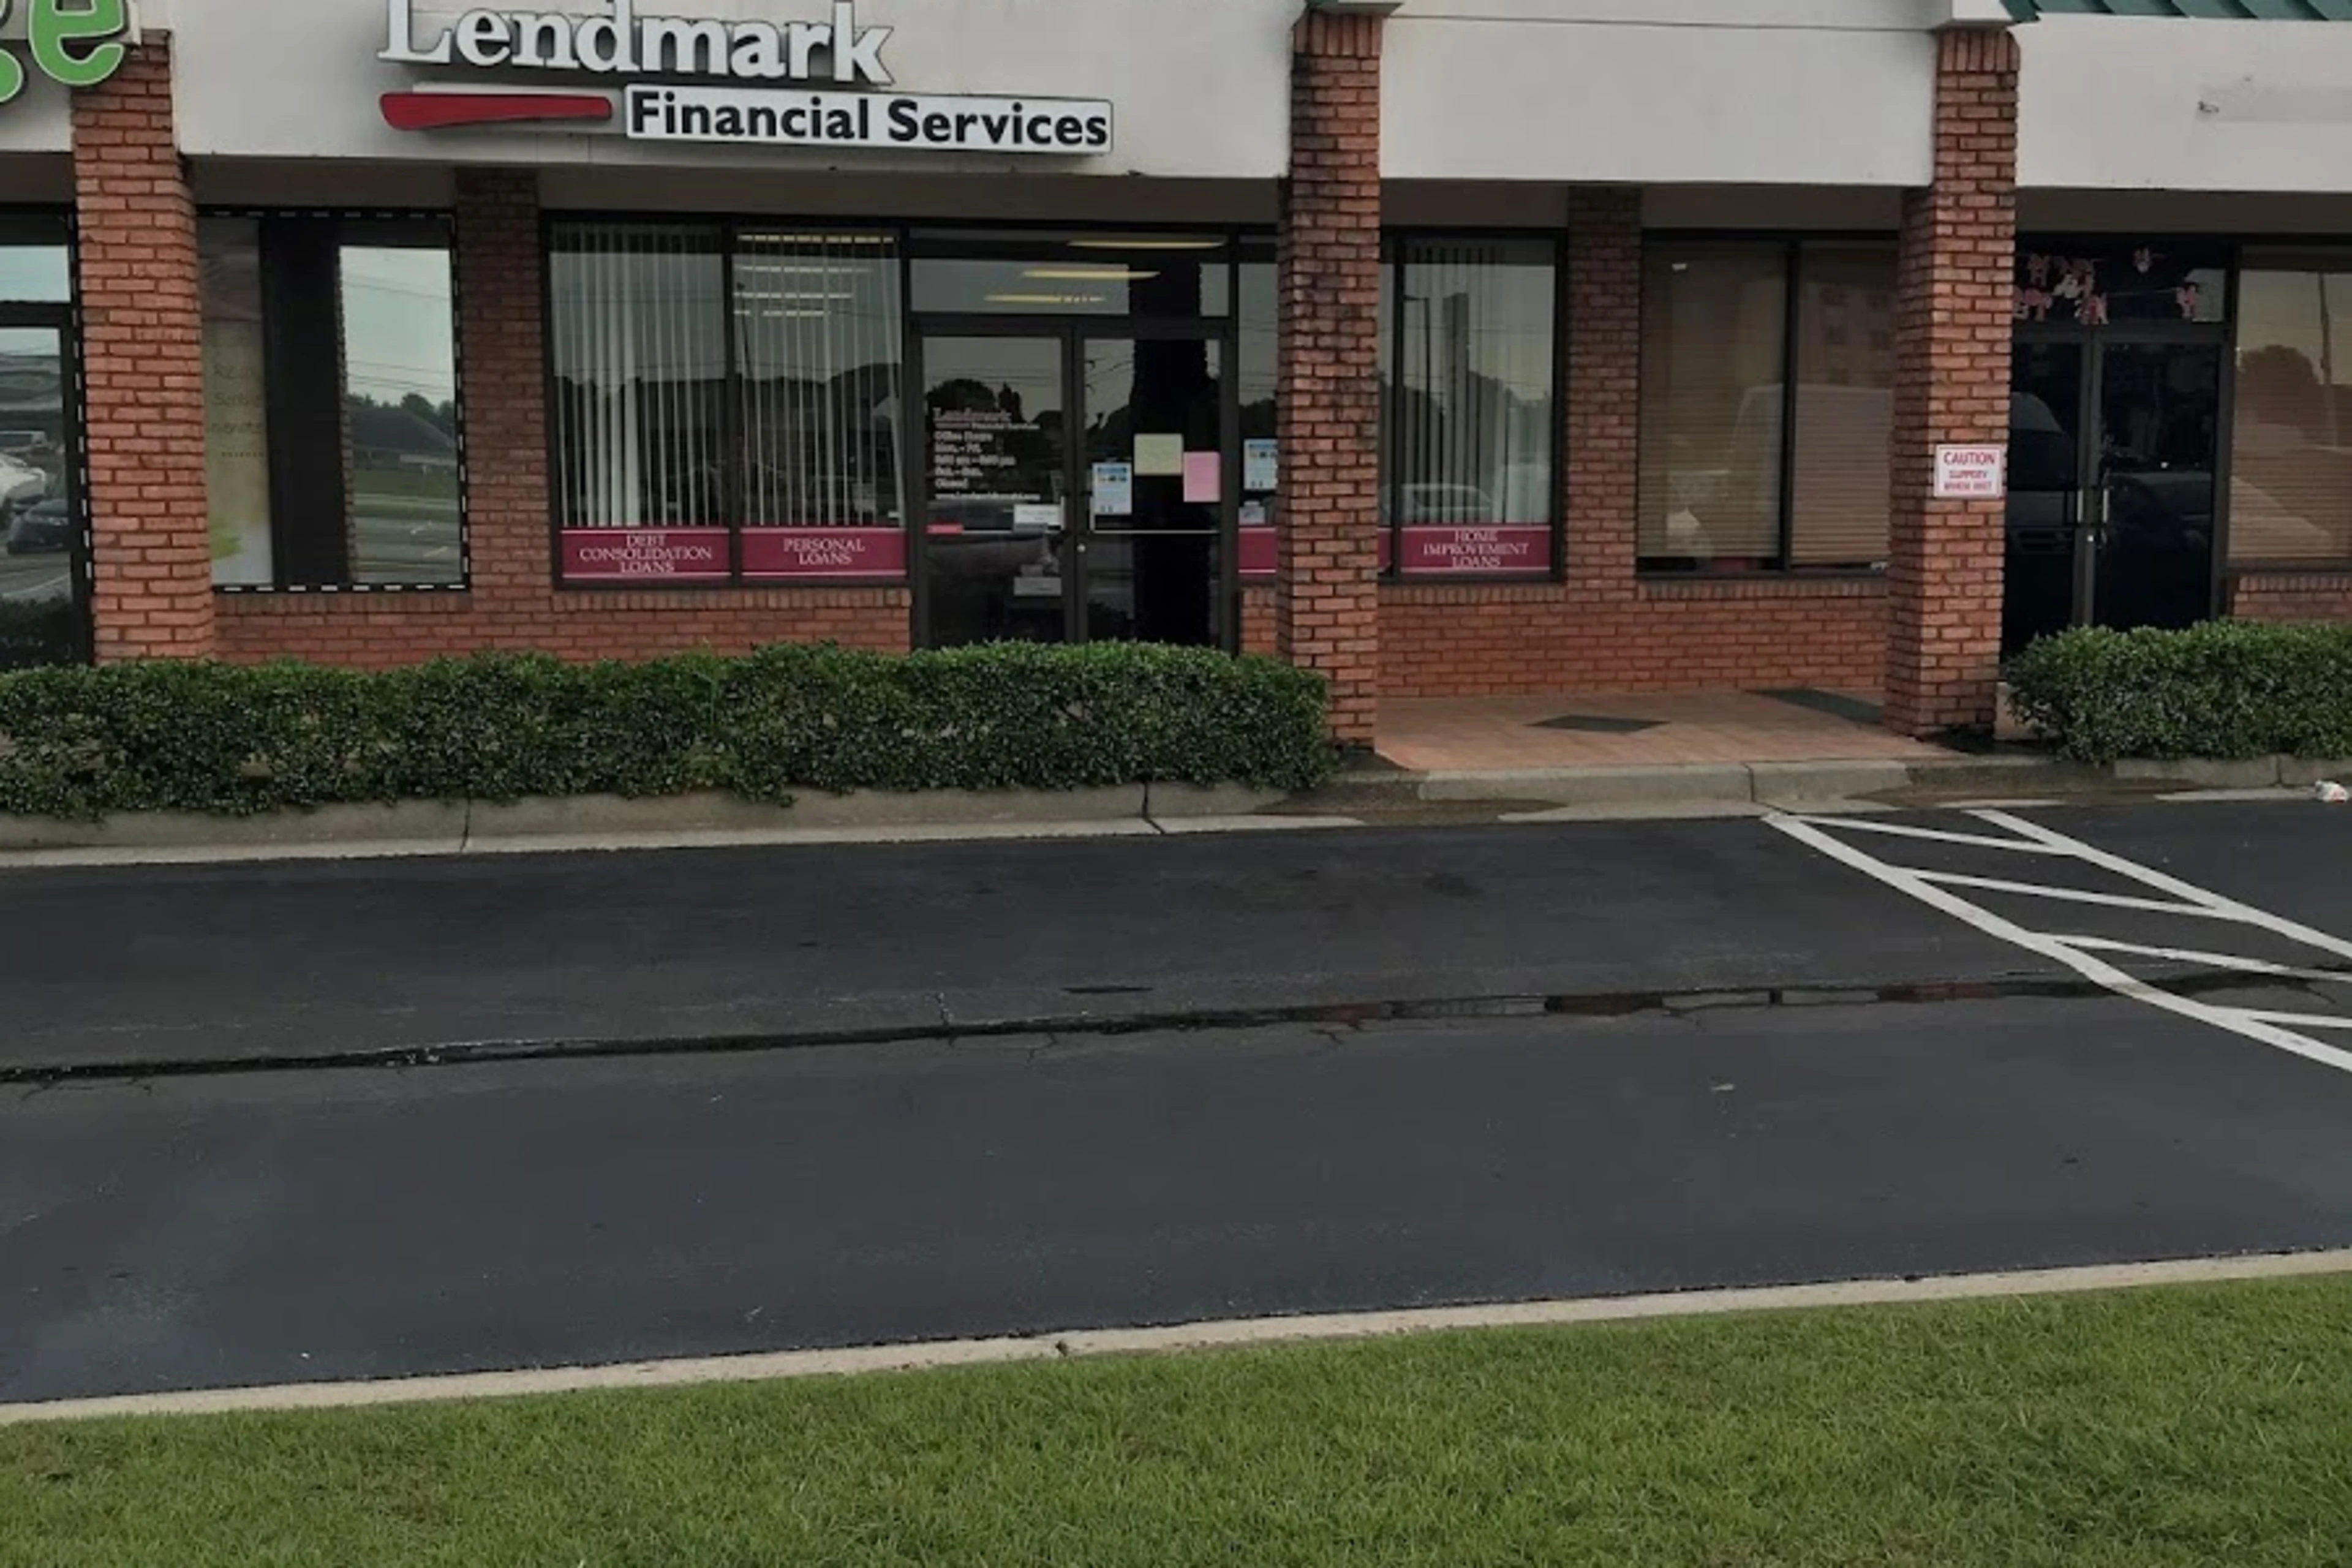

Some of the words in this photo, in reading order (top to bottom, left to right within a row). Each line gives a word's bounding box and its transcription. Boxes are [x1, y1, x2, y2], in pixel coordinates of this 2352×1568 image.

[377, 0, 895, 85] Lendmark
[631, 91, 870, 141] Financial
[888, 99, 1108, 146] Services
[1943, 452, 1995, 466] CAUTION
[626, 533, 666, 546] DEBT
[1454, 530, 1498, 542] HOME
[783, 537, 866, 552] PERSONAL
[1423, 542, 1529, 556] IMPROVEMENT
[579, 545, 712, 562] CONSOLIDATION
[799, 551, 853, 565] LOANS
[620, 560, 675, 573] LOANS
[1451, 556, 1501, 568] LOANS
